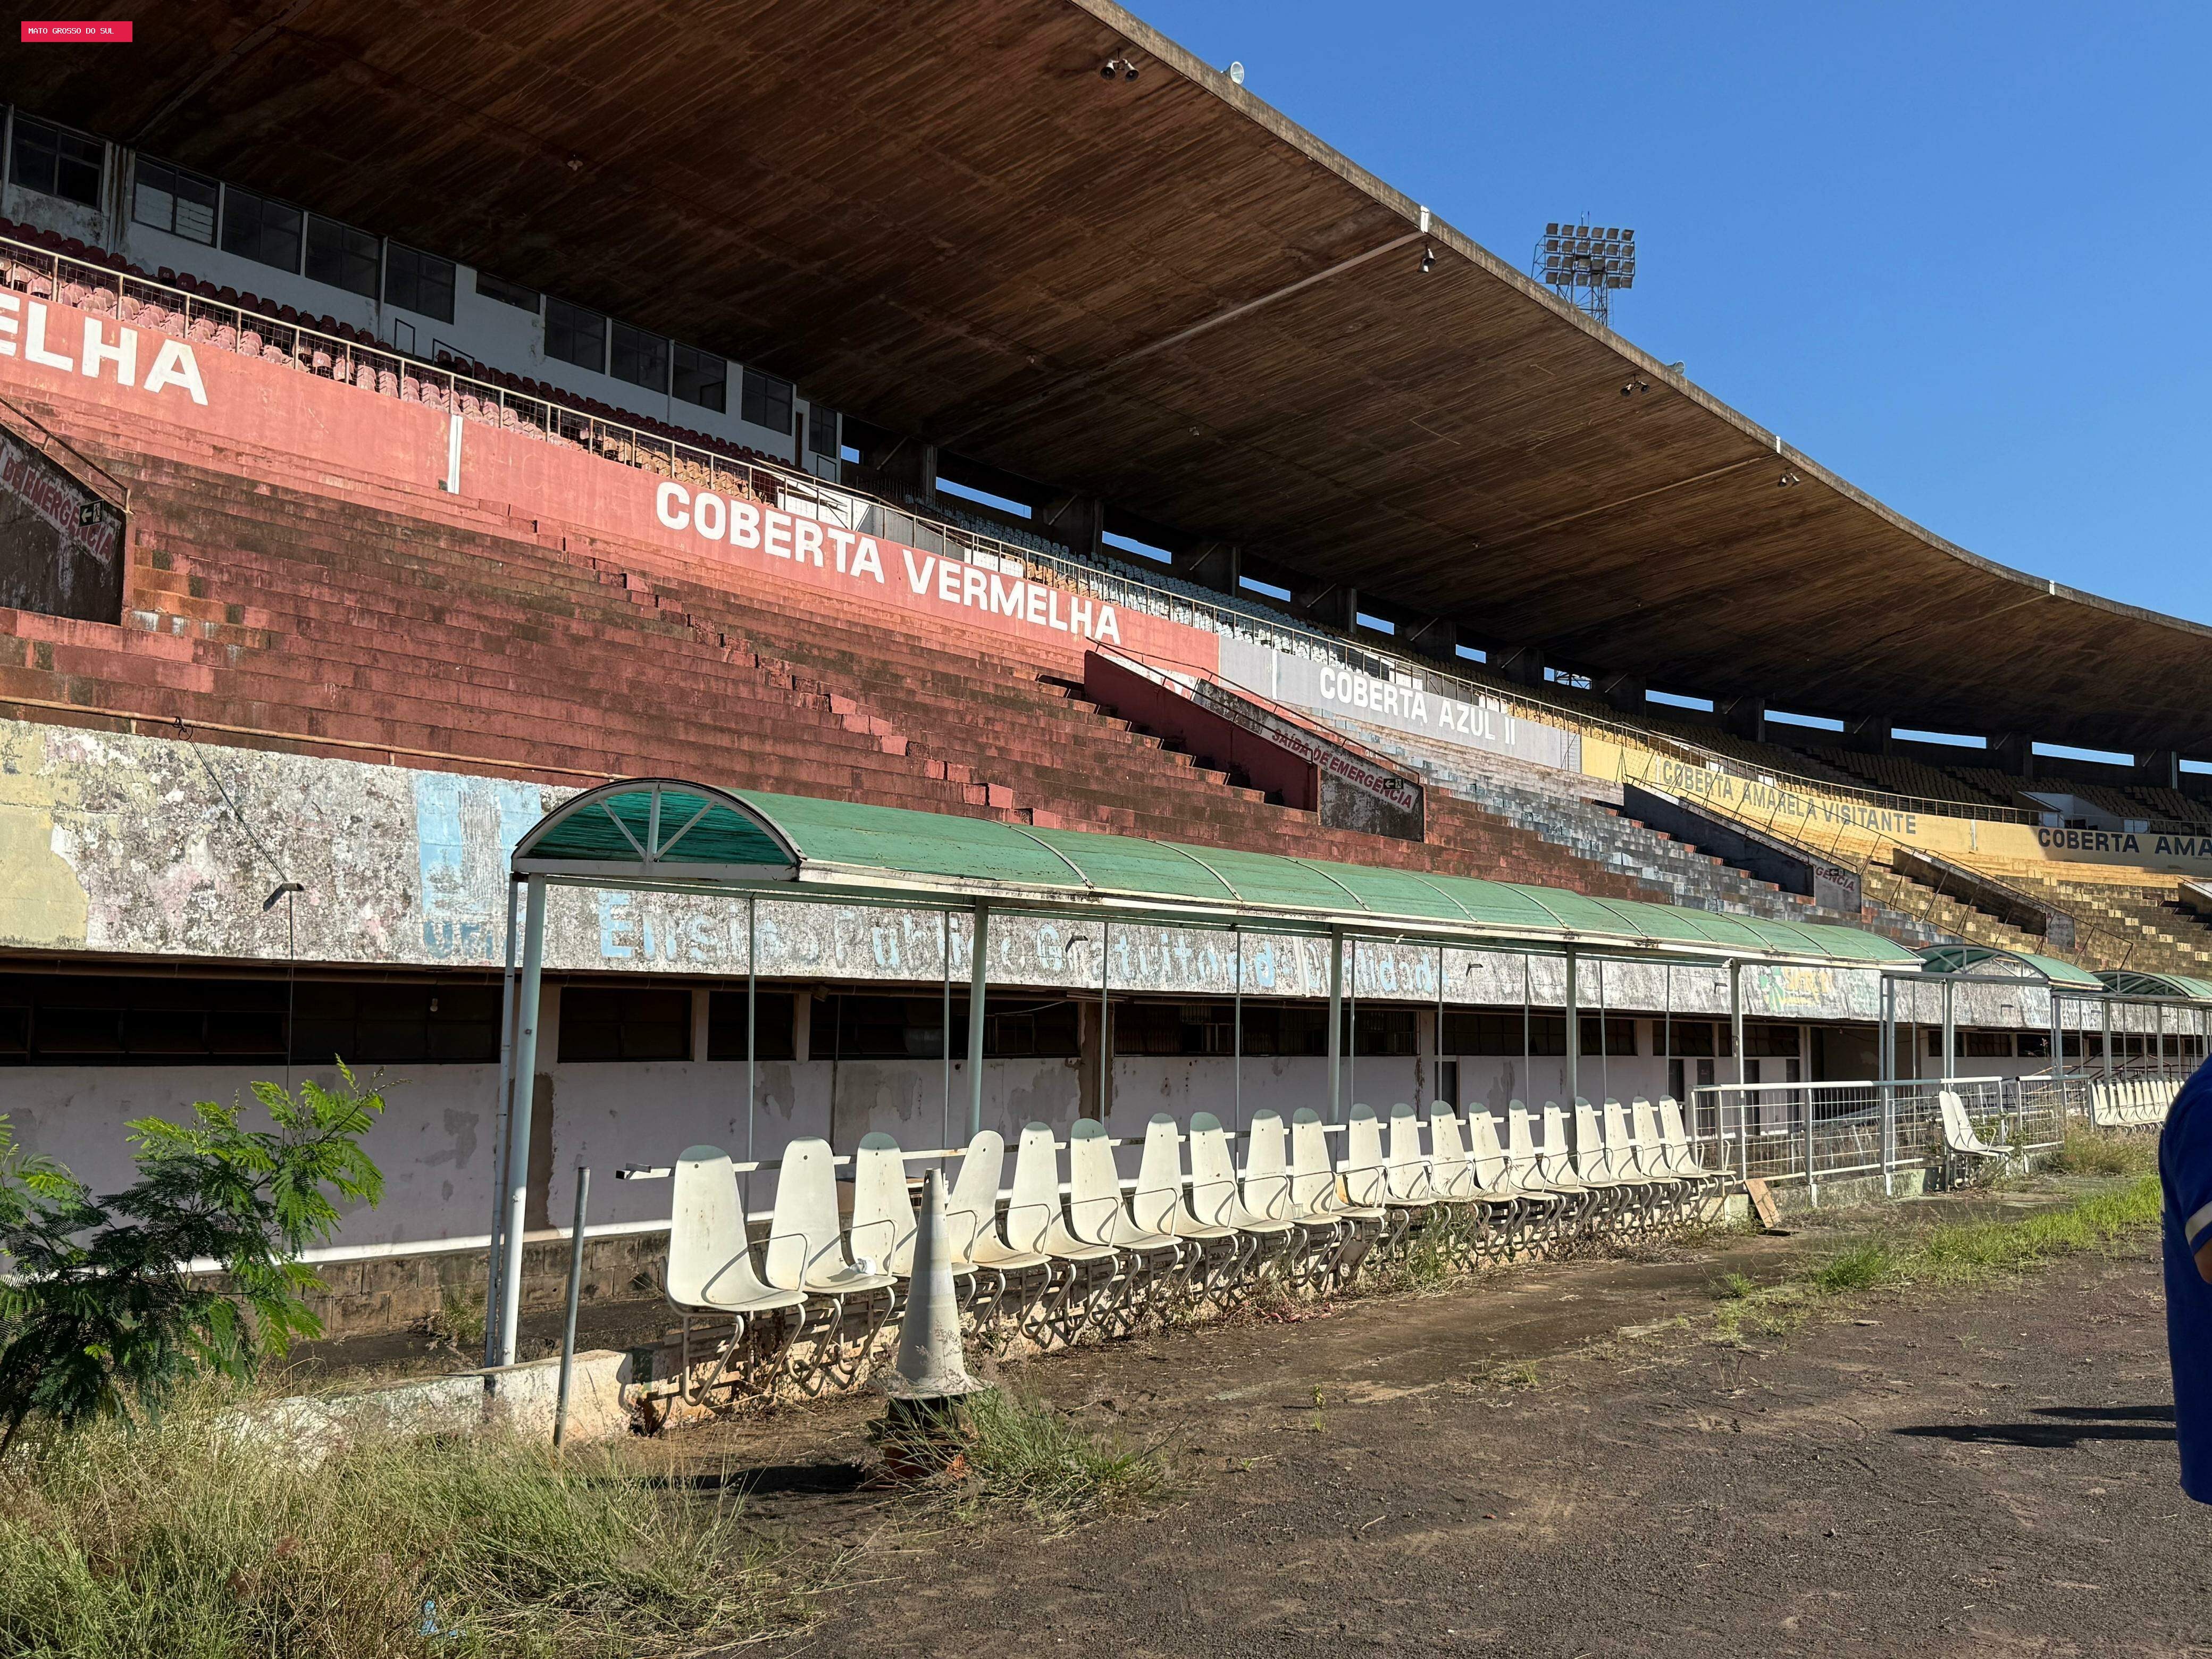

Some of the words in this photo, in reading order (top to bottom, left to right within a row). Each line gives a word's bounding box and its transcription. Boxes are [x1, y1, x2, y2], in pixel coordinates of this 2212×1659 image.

[656, 481, 885, 584] COBERTA
[902, 549, 1121, 644] VERMELHA
[1319, 666, 1428, 724] COBERTA
[1438, 700, 1495, 740] AZUL
[1504, 717, 1516, 745] II
[1313, 748, 1333, 766] DE
[1662, 760, 1734, 800] COBERTA
[1742, 782, 1817, 820] AMARELA
[1822, 801, 1917, 835] VISITANTE
[2038, 828, 2140, 853] COBERTA
[2154, 836, 2212, 857] AMA
